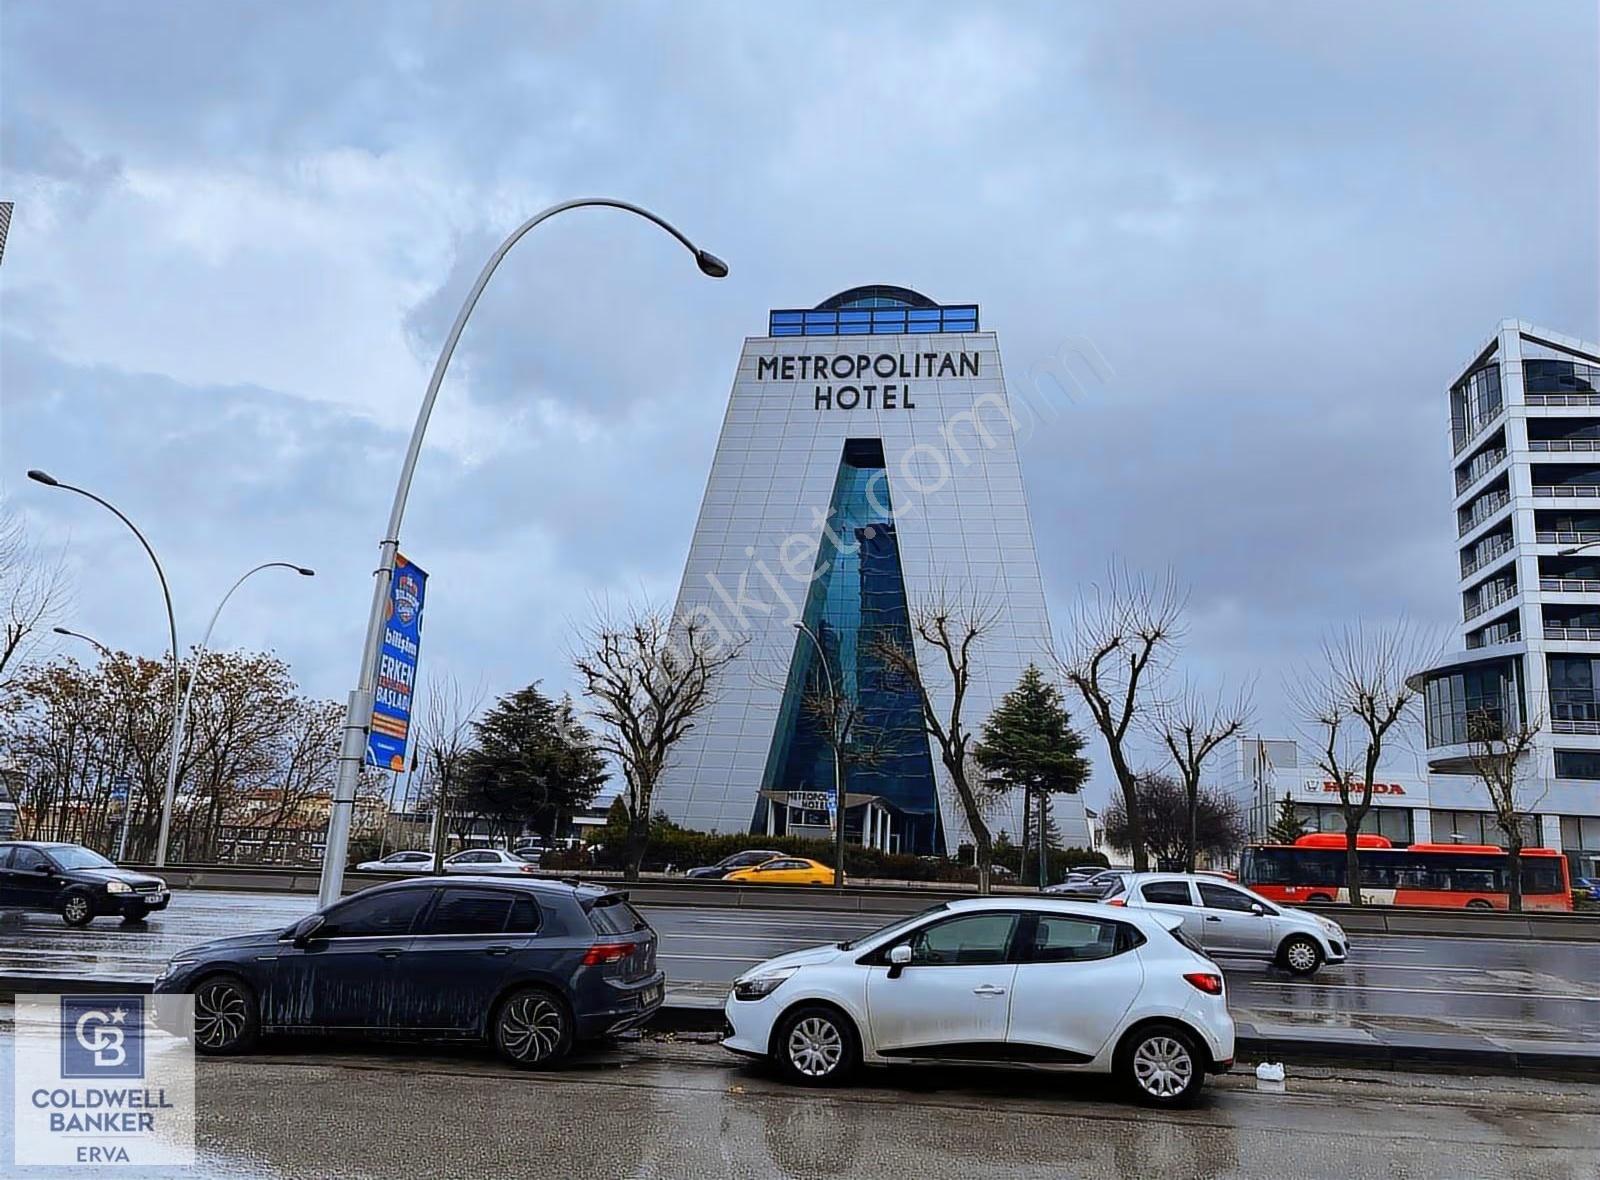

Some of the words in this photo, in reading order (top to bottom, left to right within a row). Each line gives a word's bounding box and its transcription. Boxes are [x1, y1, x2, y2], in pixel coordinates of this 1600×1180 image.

[757, 352, 980, 380] METROPOLITAN
[814, 384, 916, 410] HOTEL
[380, 653, 415, 687] ERKEN
